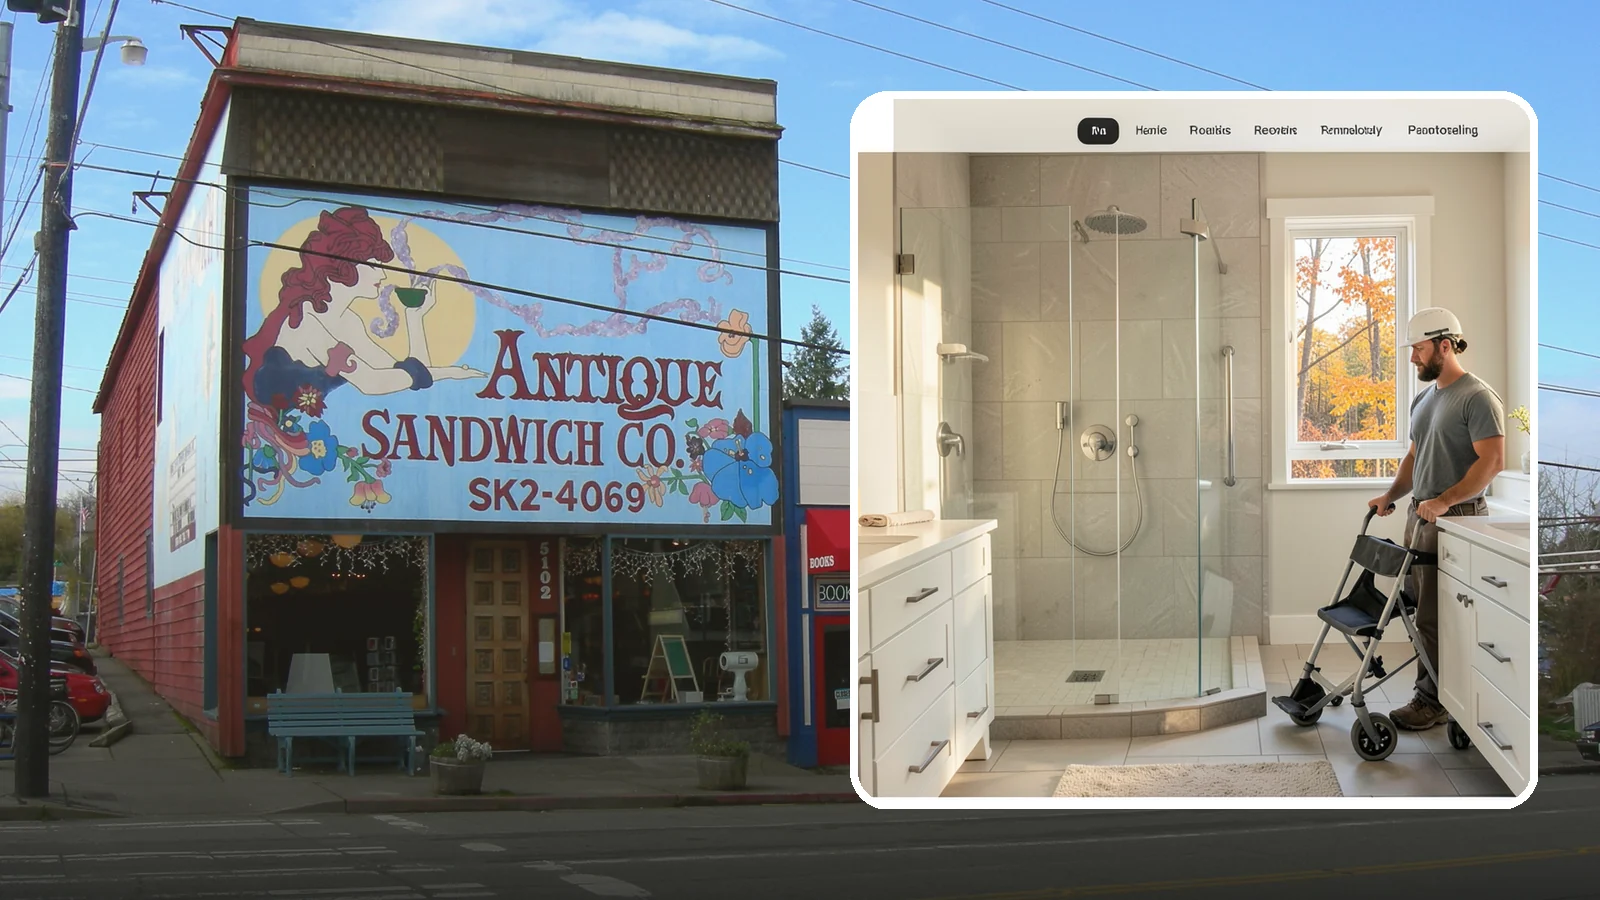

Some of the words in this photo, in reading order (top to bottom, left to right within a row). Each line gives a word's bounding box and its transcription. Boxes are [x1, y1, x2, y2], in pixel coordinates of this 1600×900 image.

[475, 328, 724, 421] ANTIQUE
[361, 408, 605, 468] SANDWICH
[617, 421, 685, 470] CO.
[468, 476, 646, 513] SK2-4069
[540, 542, 552, 600] 5102
[809, 555, 835, 569] BOOKS
